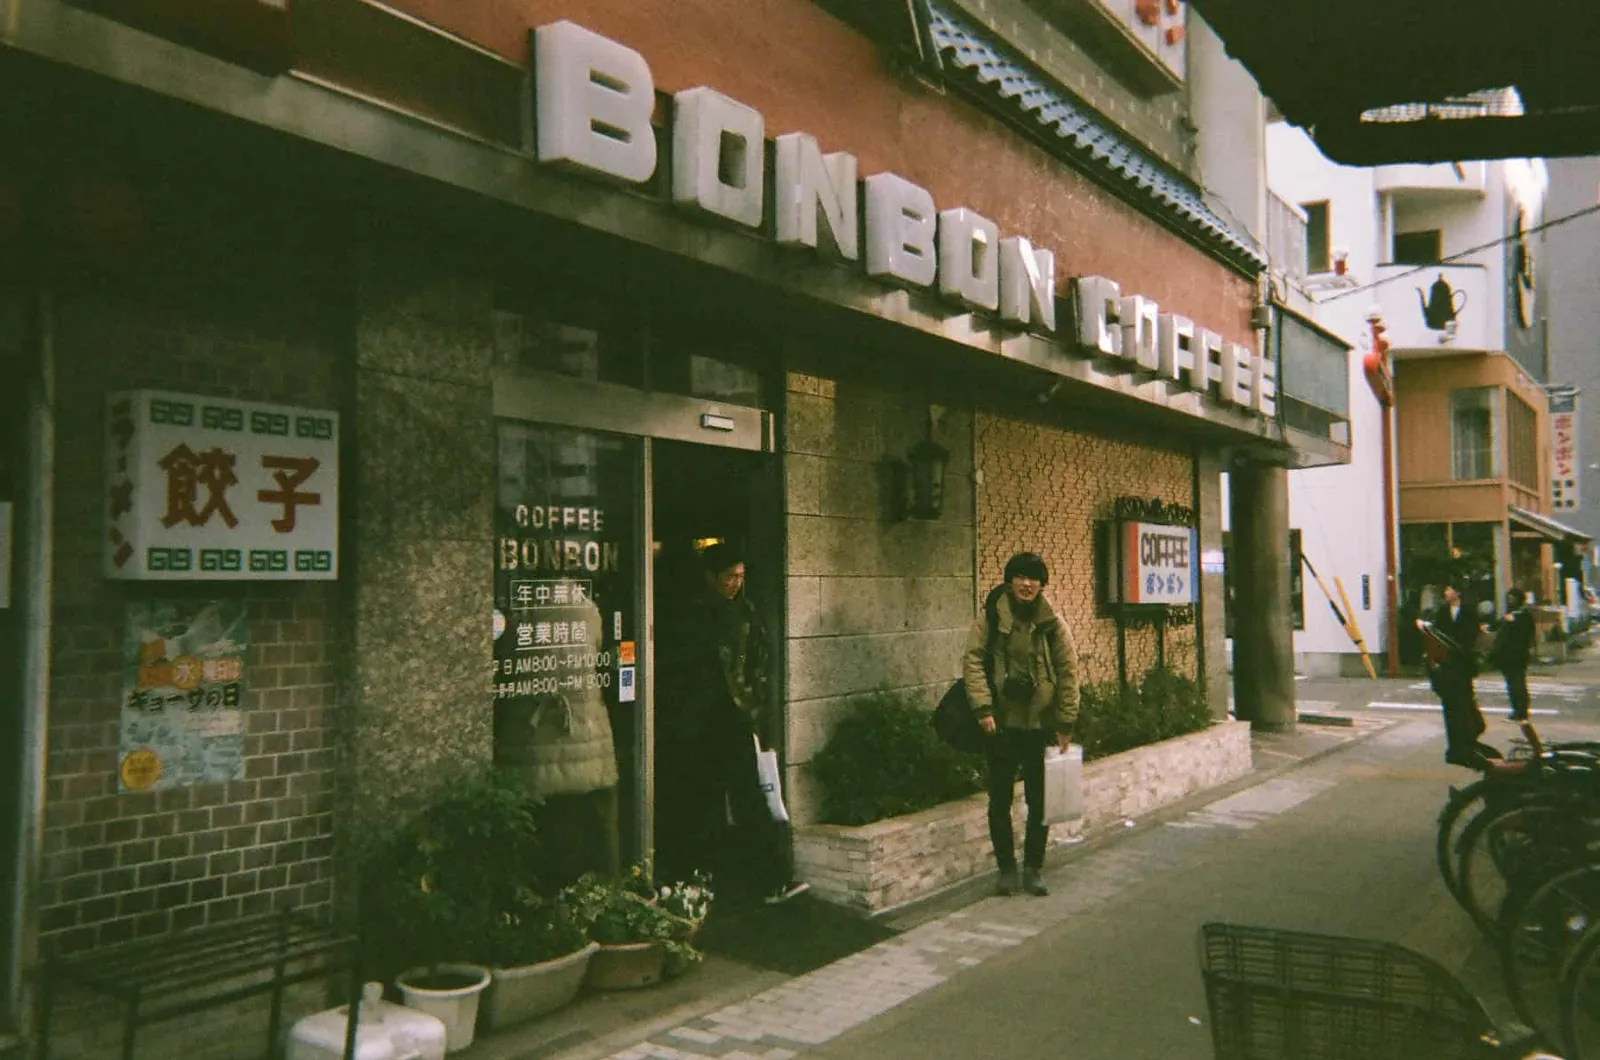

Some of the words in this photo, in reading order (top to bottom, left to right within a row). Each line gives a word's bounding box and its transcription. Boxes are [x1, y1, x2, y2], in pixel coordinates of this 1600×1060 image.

[532, 19, 1055, 331] BONBON
[1075, 275, 1276, 417] COFFEE
[157, 441, 321, 534] 餃子
[515, 504, 605, 531] COFFEE
[499, 538, 619, 572] BONBON
[1141, 532, 1189, 568] COFFEE
[516, 584, 588, 605] 年中無休
[516, 620, 588, 646] 営業時間
